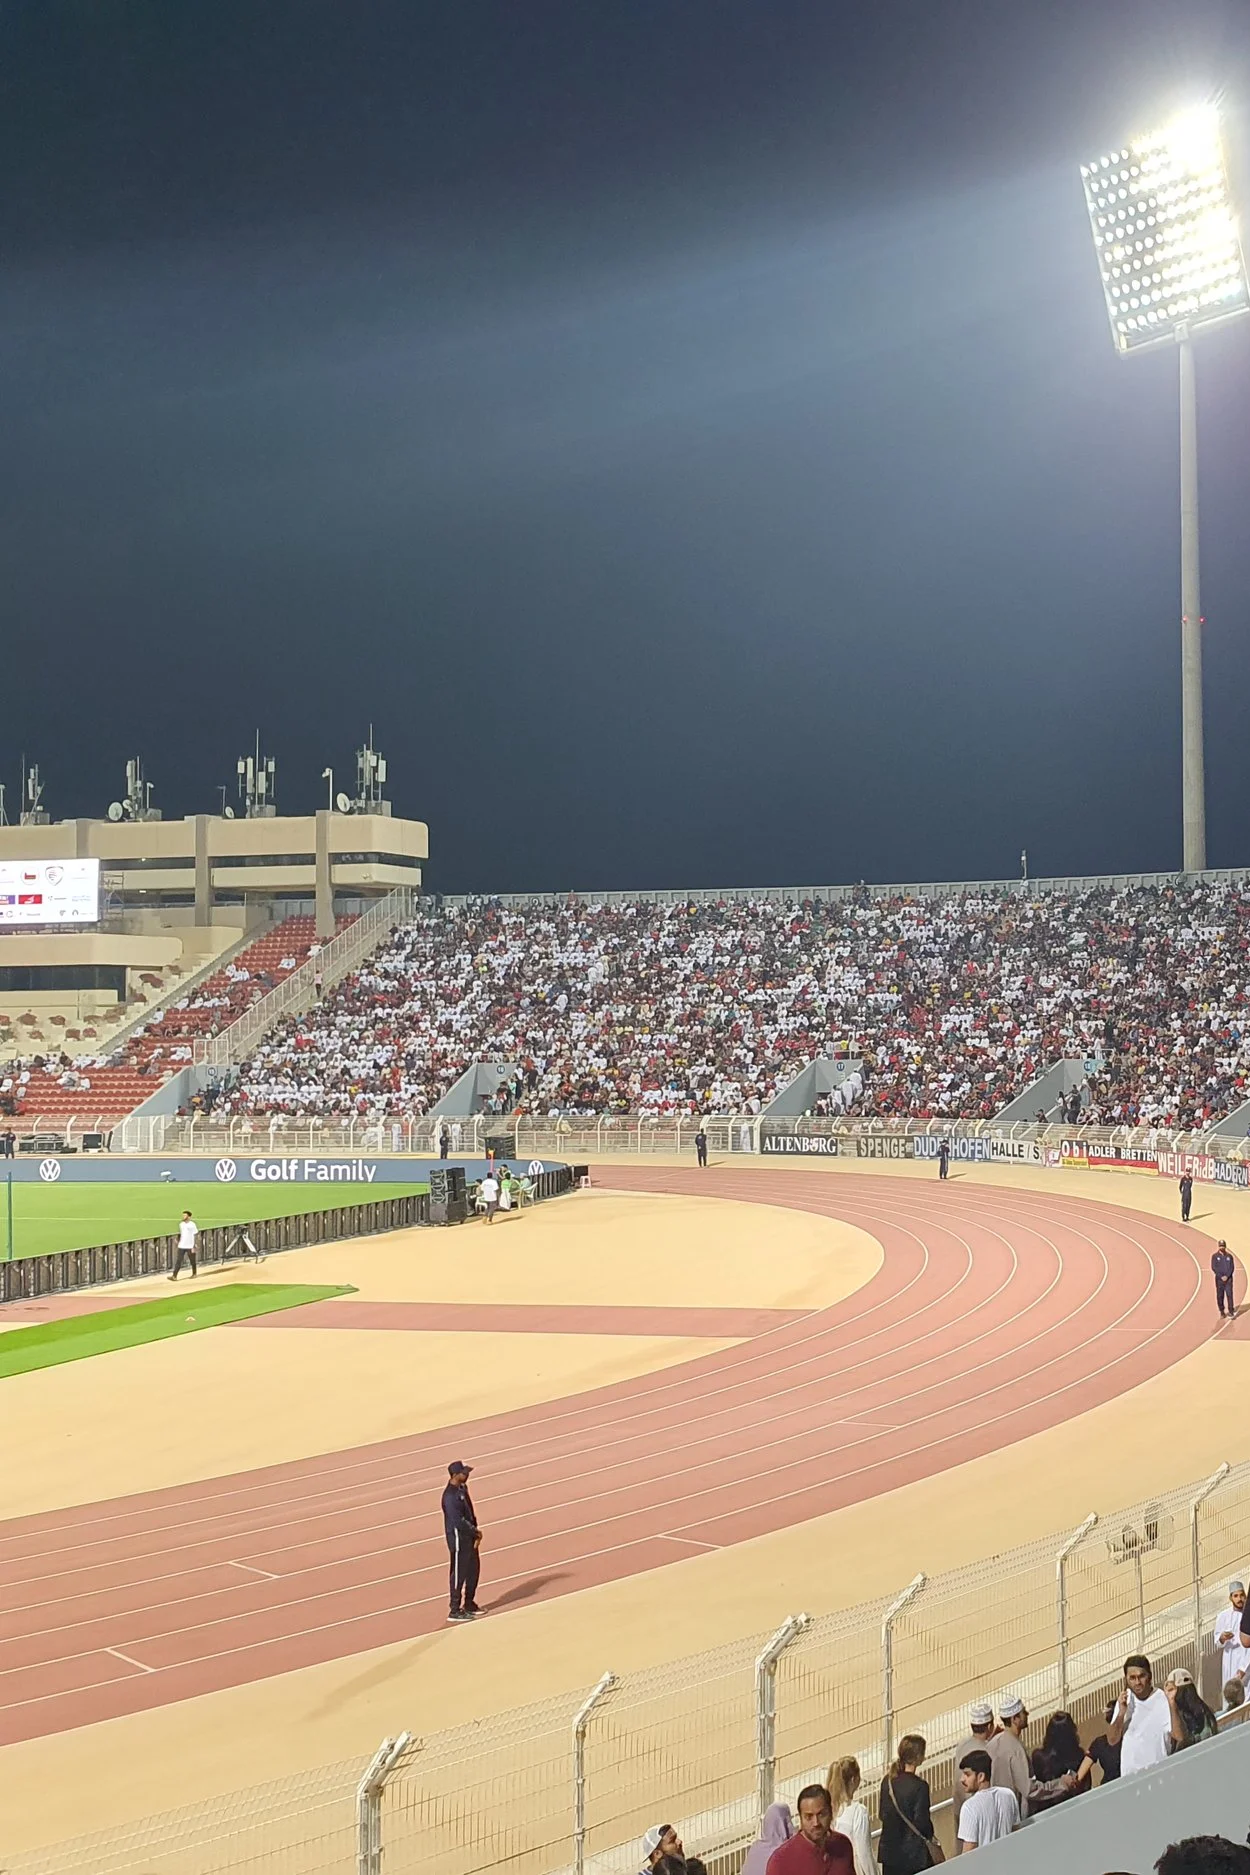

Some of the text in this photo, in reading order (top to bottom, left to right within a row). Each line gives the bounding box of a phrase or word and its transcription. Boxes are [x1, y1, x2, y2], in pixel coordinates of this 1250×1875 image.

[860, 1137, 906, 1158] SPENGE
[991, 1141, 1025, 1159] HALLE
[1088, 1145, 1158, 1162] ADLER BRETTEN
[250, 1158, 377, 1183] Golf Family
